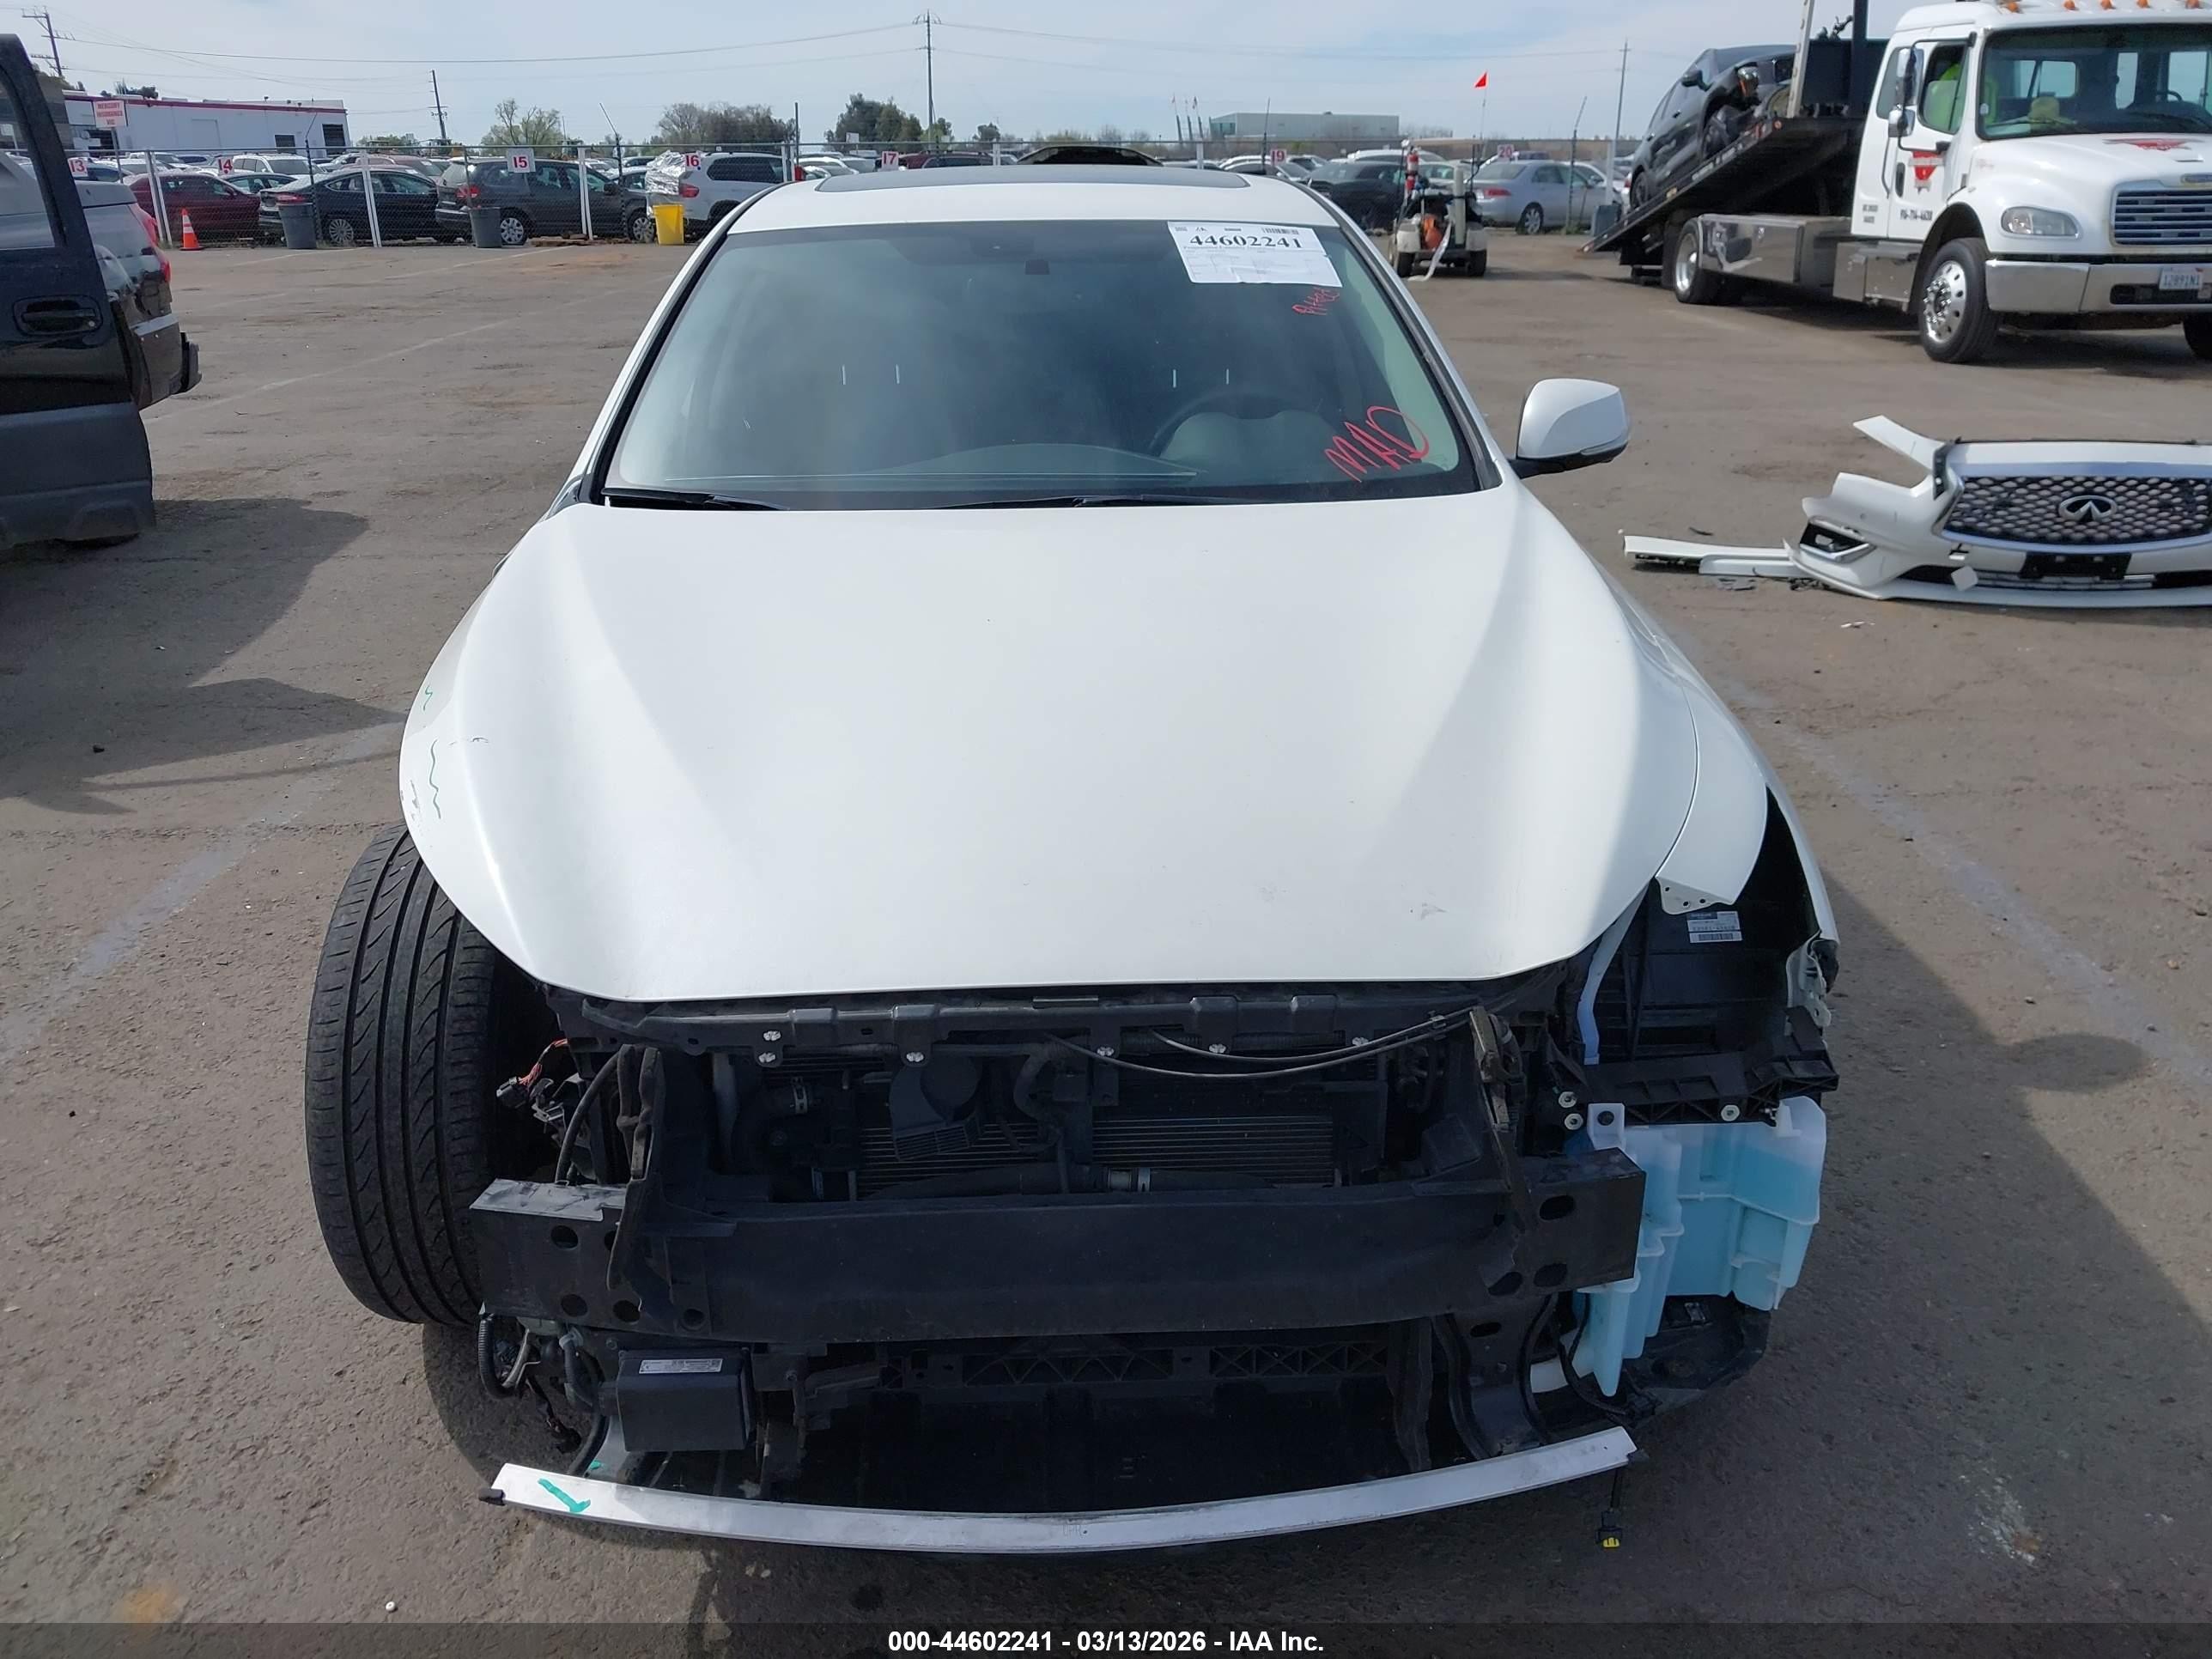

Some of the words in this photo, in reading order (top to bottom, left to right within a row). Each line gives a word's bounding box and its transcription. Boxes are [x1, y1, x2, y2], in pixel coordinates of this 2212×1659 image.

[512, 155, 527, 168] 15
[685, 155, 701, 167] 16
[883, 152, 897, 165] 17
[1272, 150, 1285, 162] 19
[70, 159, 85, 173] 13
[217, 158, 234, 171] 14
[1189, 235, 1304, 248] 44602241
